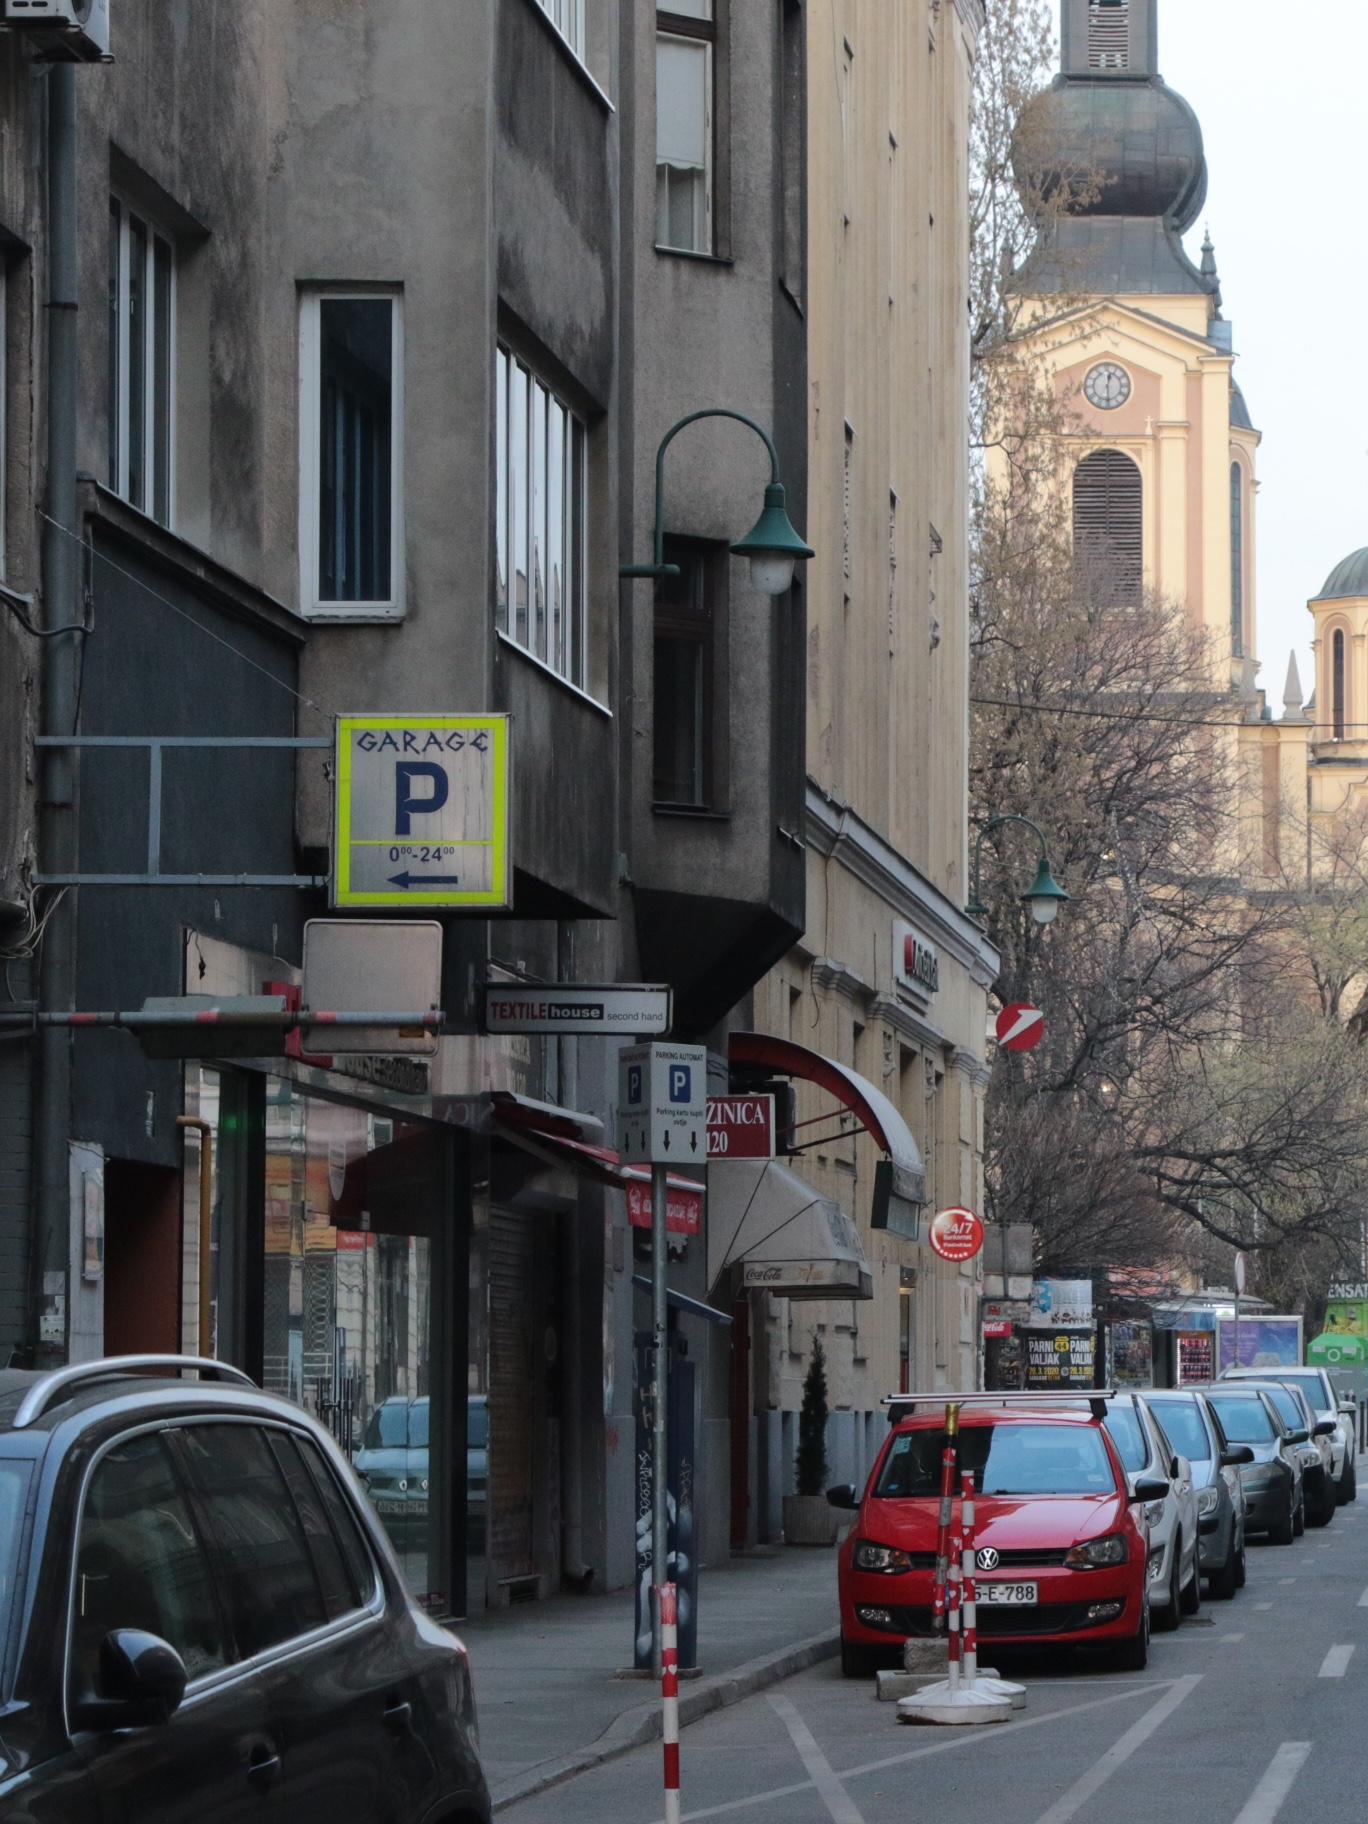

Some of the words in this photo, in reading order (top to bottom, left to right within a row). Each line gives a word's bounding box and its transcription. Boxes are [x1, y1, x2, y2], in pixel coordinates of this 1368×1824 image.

[356, 730, 488, 755] GARAGE
[395, 761, 449, 835] P
[491, 1003, 546, 1019] TEXTILE
[551, 1007, 601, 1018] house
[607, 1013, 639, 1021] second
[641, 1012, 663, 1021] hand
[656, 1051, 677, 1060] PARKING
[674, 1071, 686, 1096] P
[943, 1222, 973, 1234] 24/7
[1029, 1340, 1054, 1352] PARNI
[1029, 1353, 1060, 1365] VALJAK
